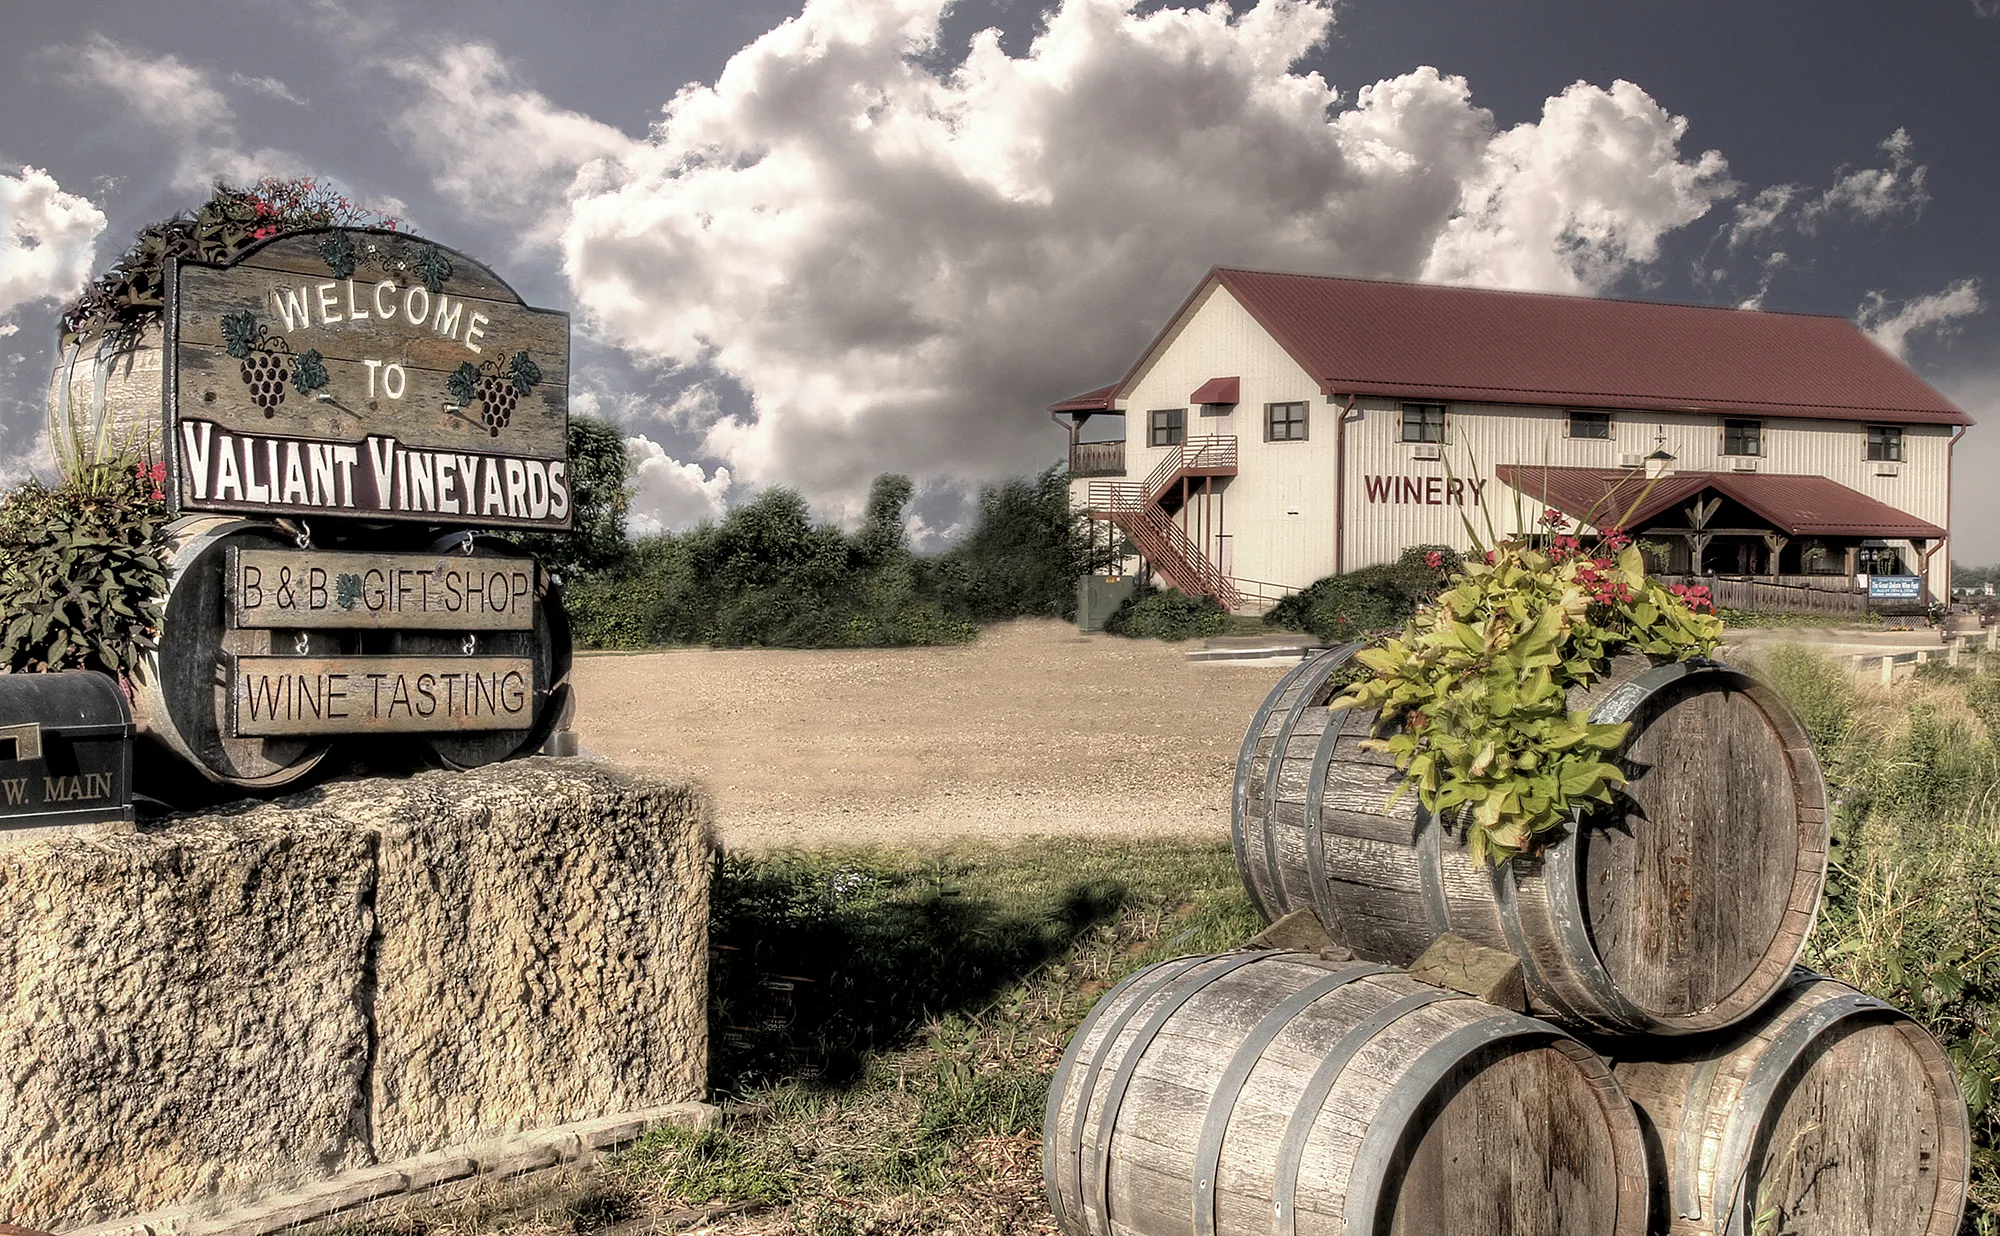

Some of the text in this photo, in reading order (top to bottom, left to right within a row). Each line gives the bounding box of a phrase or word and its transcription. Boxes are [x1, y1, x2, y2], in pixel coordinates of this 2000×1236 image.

[273, 278, 491, 355] WELCOME
[363, 358, 406, 400] TO
[182, 420, 569, 520] VALIANT VINEYARDS
[1364, 474, 1487, 506] WINERY
[243, 565, 530, 616] B & B GIFT SHOP
[246, 669, 526, 721] WINE TASTING
[2, 771, 114, 806] W. MAIN
